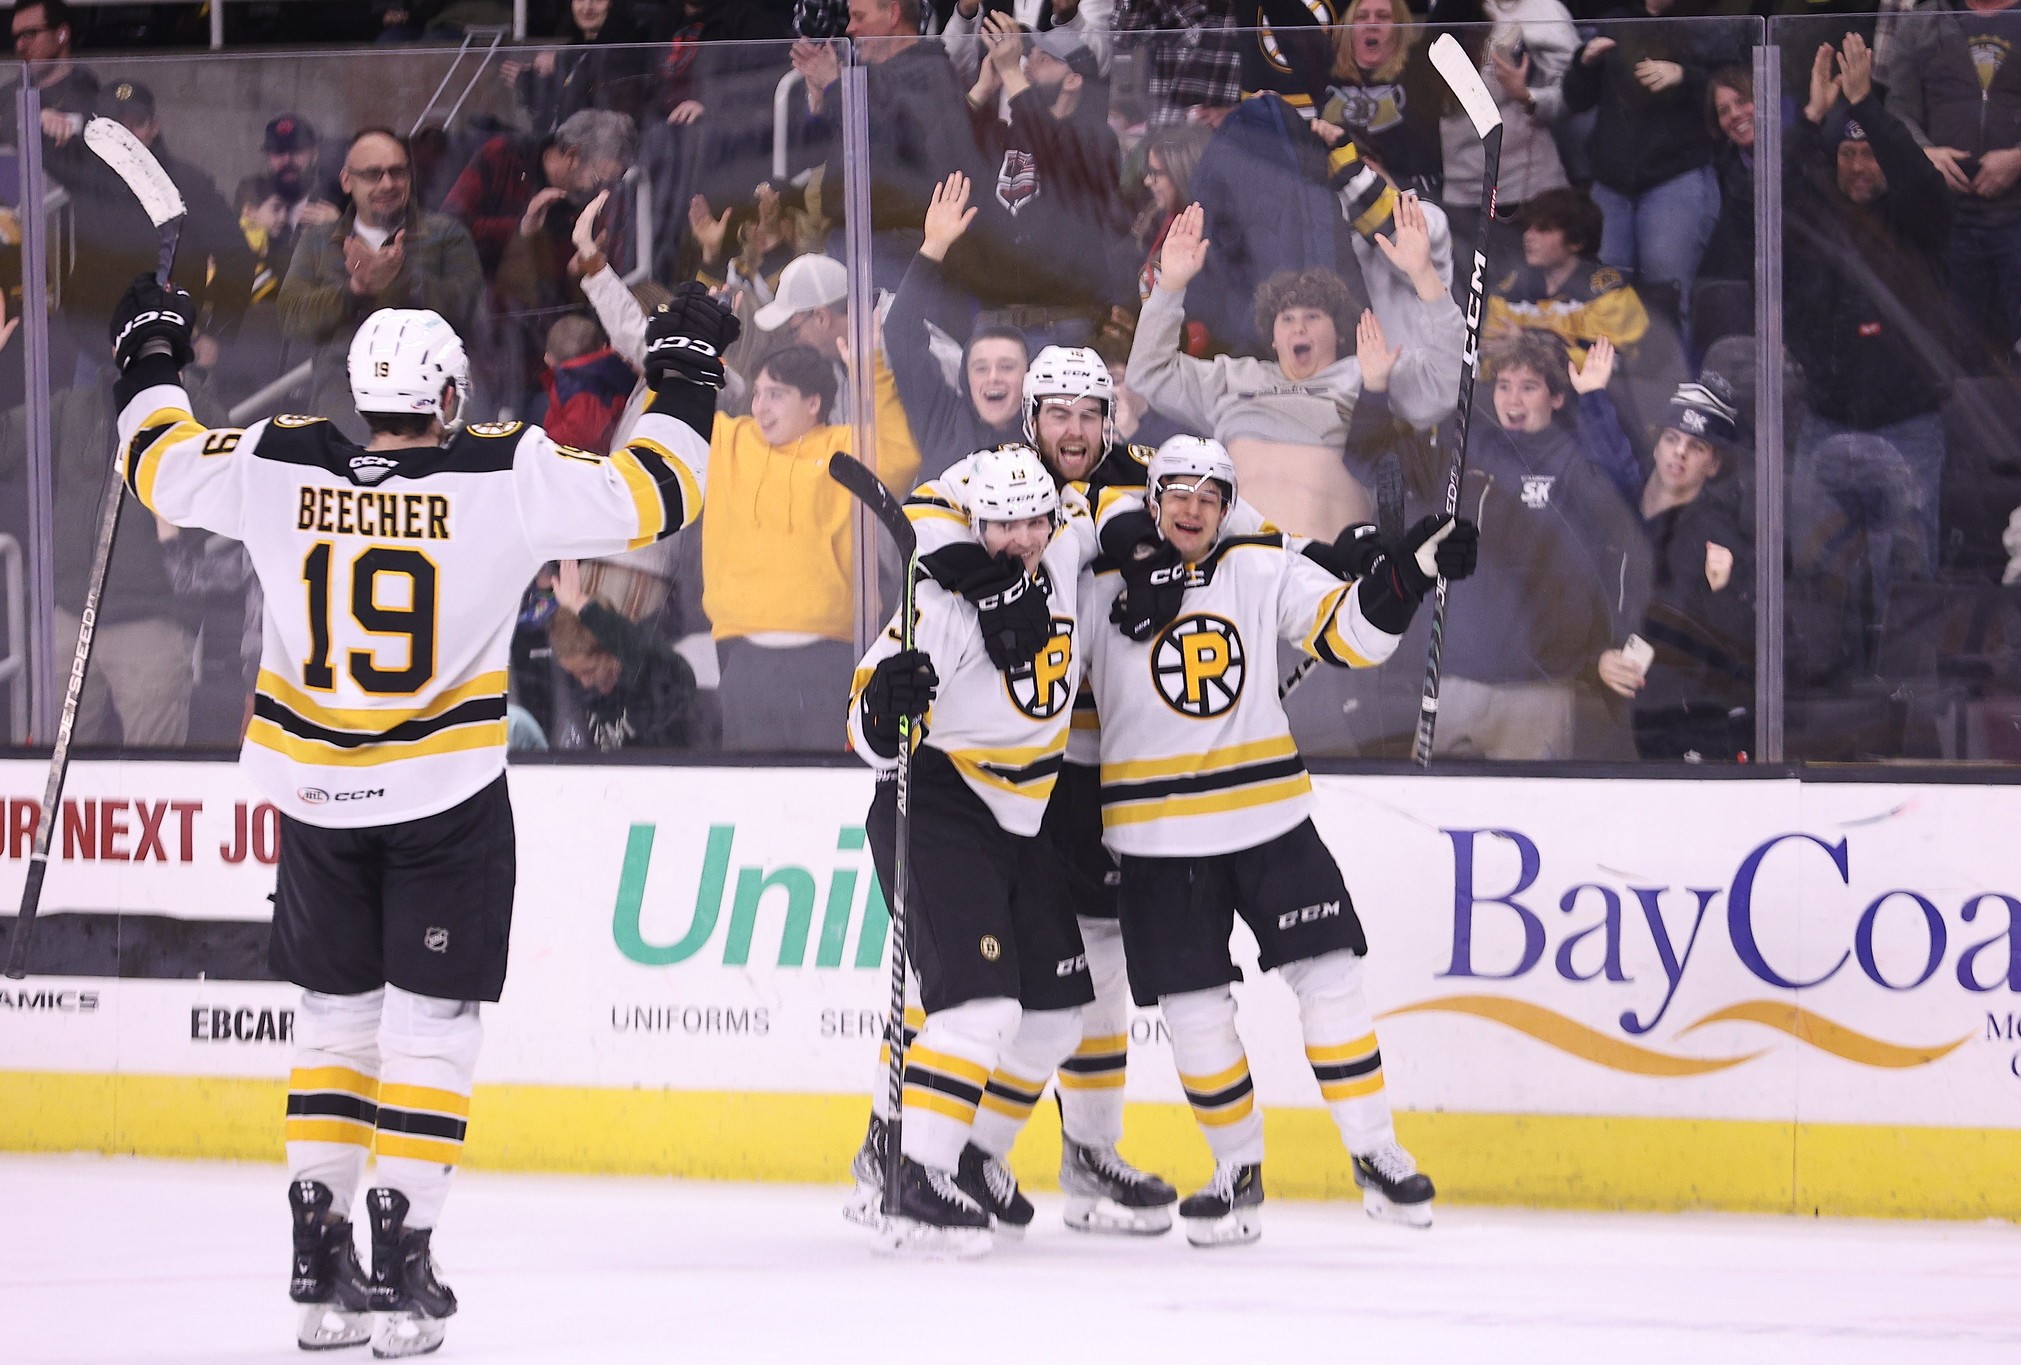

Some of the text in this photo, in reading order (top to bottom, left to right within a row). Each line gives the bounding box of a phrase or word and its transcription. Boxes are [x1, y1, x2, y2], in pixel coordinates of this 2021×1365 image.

[1462, 249, 1487, 367] CCM
[374, 361, 391, 378] 19
[348, 455, 400, 469] CCM
[1520, 480, 1551, 502] SK
[297, 485, 451, 541] BEECHER
[1150, 560, 1185, 586] CC
[300, 540, 441, 697] 19
[58, 608, 96, 746] JETSPEED
[334, 788, 385, 801] CCM
[897, 741, 909, 818] ALPHA
[62, 798, 203, 863] NEXT
[1278, 900, 1341, 930] CCM
[1434, 826, 2021, 1034] BayCoa
[611, 1005, 769, 1036] UNIFORMS
